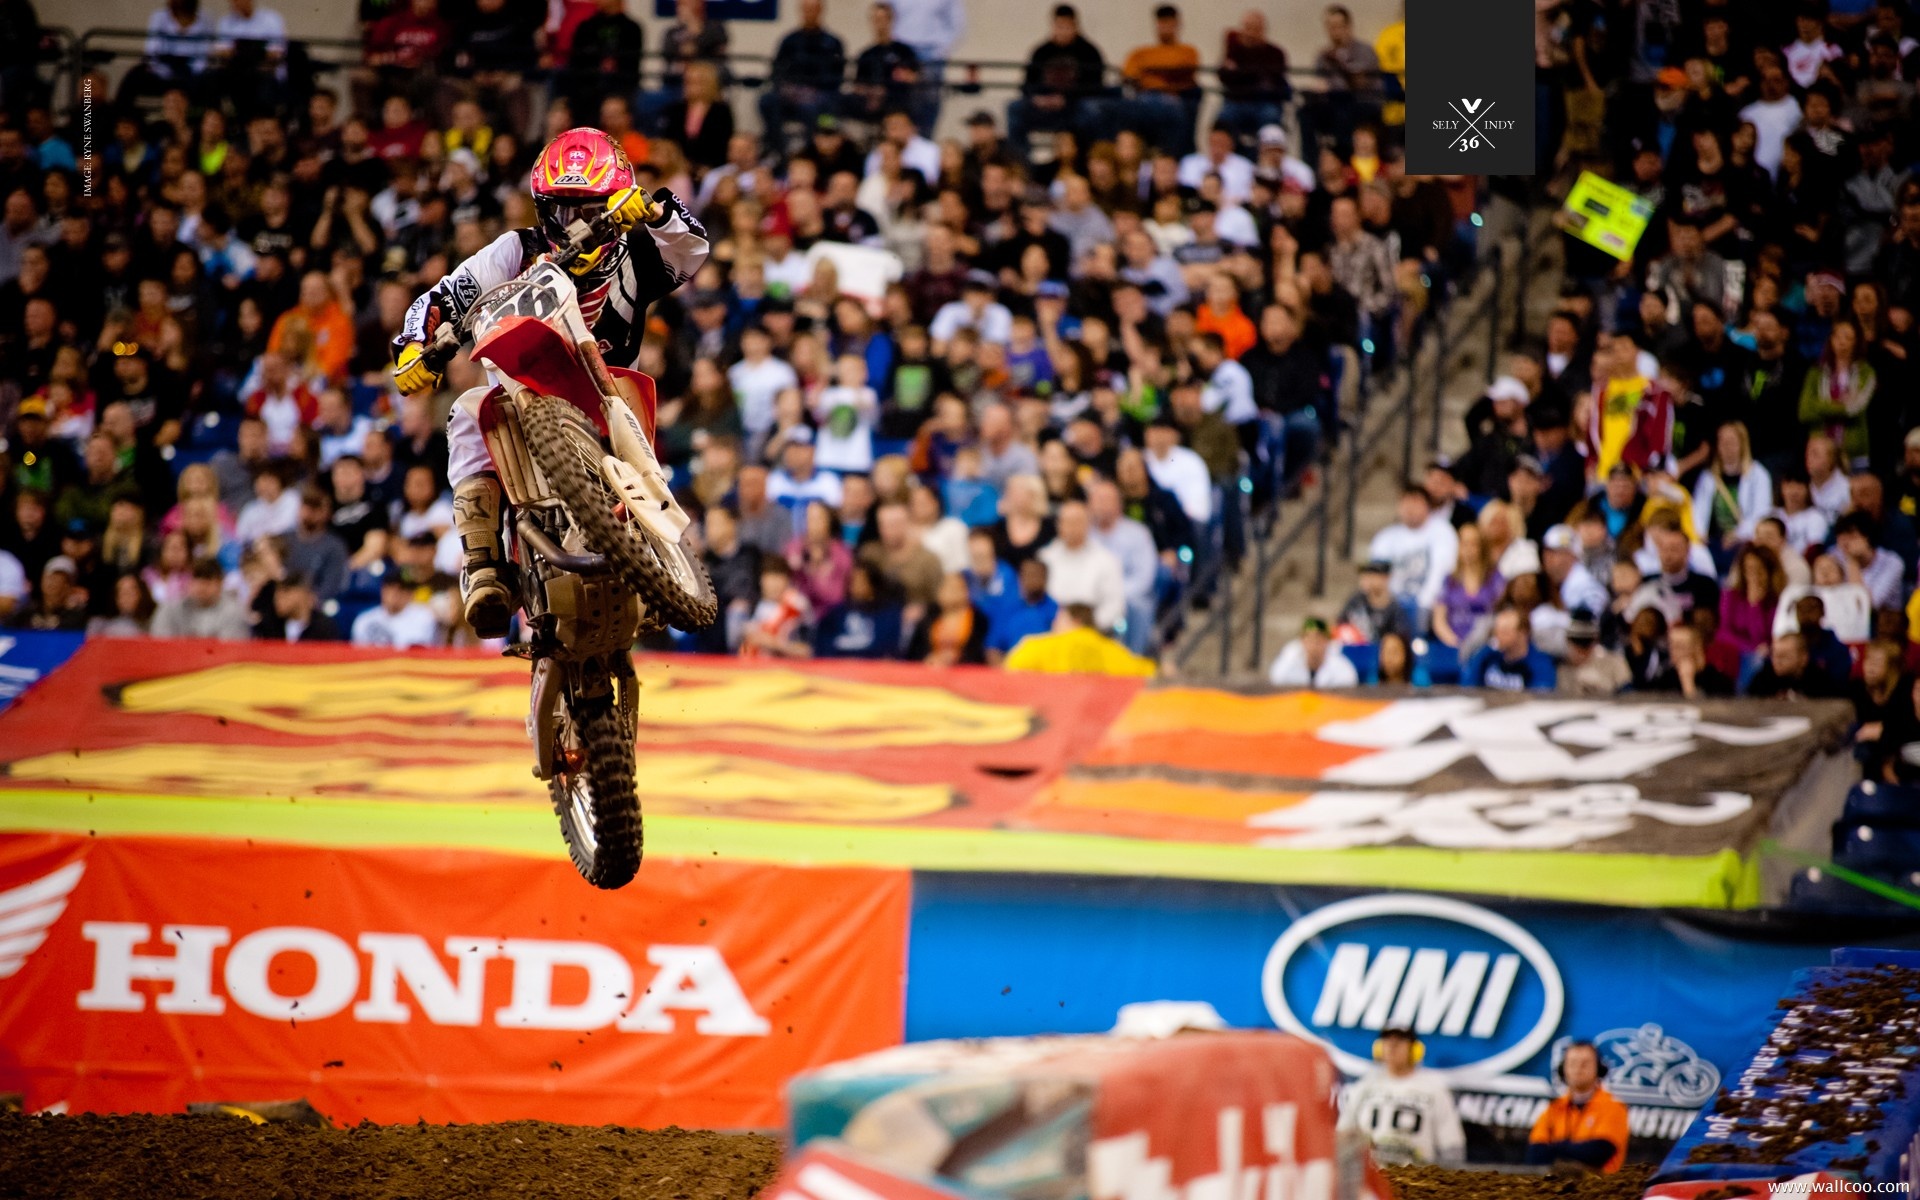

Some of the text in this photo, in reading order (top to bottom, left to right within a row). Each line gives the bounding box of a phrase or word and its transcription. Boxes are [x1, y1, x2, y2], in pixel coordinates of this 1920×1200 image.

[624, 413, 655, 460] DUNLOP
[77, 921, 772, 1037] HONDA
[1311, 942, 1521, 1039] MMI
